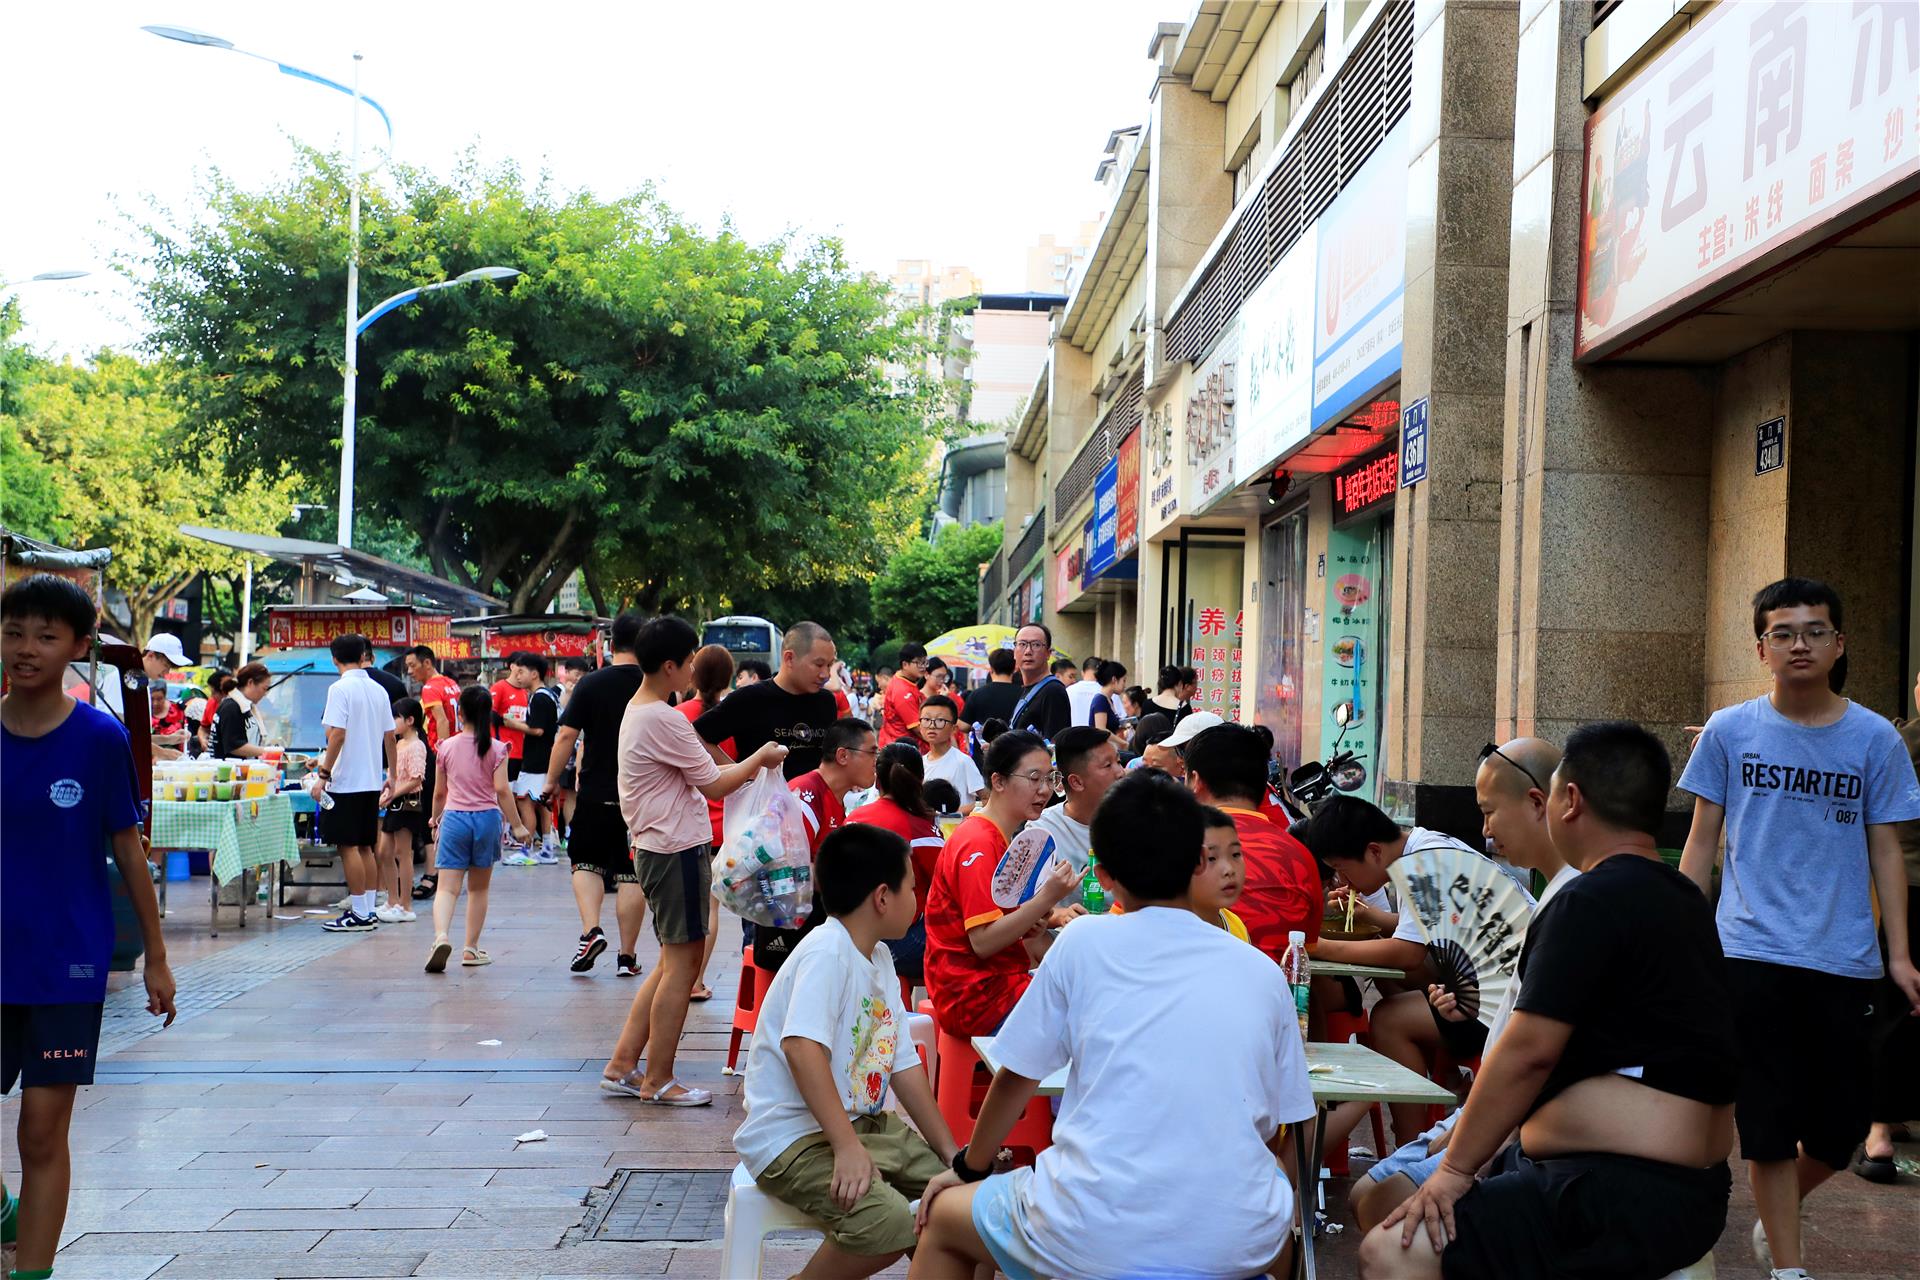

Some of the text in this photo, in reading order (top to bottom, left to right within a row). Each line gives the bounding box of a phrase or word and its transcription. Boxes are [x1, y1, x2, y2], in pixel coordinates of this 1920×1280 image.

[1344, 451, 1398, 513] 离百年老店还有
[1742, 763, 1862, 800] RESTARTED
[1835, 809, 1858, 825] 087
